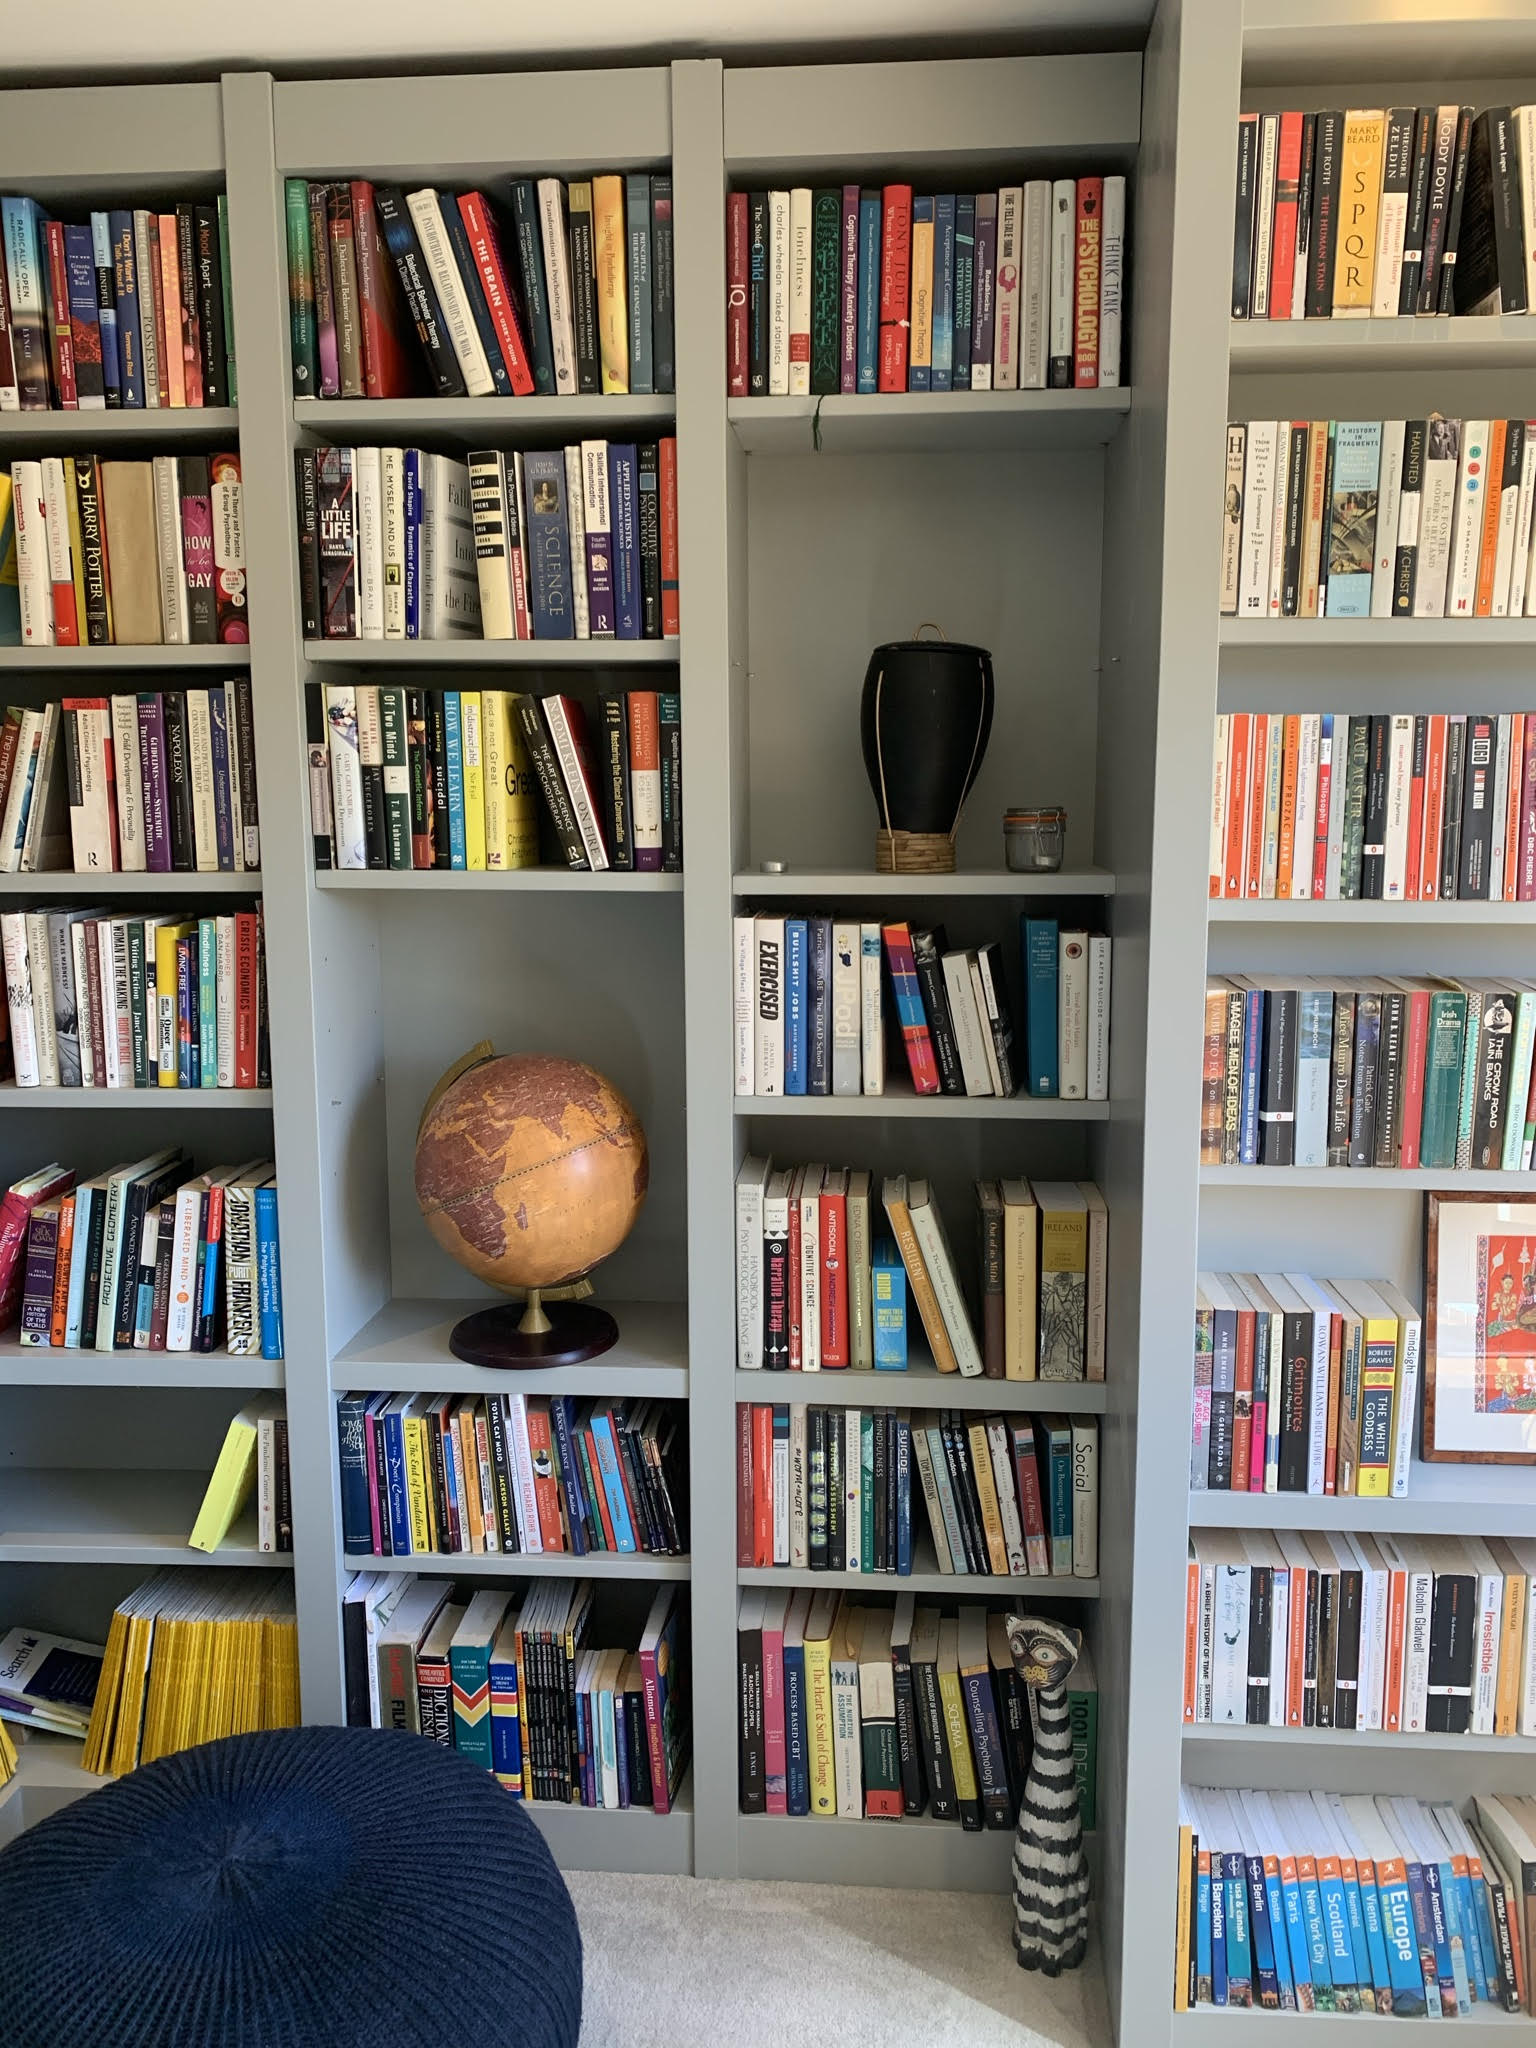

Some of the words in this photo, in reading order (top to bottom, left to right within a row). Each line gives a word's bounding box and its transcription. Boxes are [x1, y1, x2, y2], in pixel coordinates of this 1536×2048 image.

[1325, 119, 1334, 152] PHILIP
[1348, 136, 1380, 144] BEARD
[1388, 126, 1400, 178] ZELDIN
[1400, 126, 1410, 178] THEODORE
[1438, 118, 1452, 162] RODDY
[1322, 156, 1332, 184] ROTH
[1432, 167, 1446, 210] DOYLE
[200, 219, 209, 228] A
[755, 205, 763, 222] The
[1080, 219, 1099, 230] THE
[16, 219, 25, 269] RADICALLY
[21, 269, 30, 298] OPEN
[200, 229, 211, 257] Mood
[1105, 236, 1121, 276] THINK
[201, 258, 212, 288] Apart
[752, 245, 764, 281] Child
[99, 266, 108, 306] MINDFUL
[405, 254, 418, 289] Dialectical
[417, 289, 430, 321] Behavior
[427, 321, 440, 349] Therapy
[476, 238, 490, 262] THE
[484, 267, 502, 307] BRAIN
[500, 318, 513, 342] USER'S
[508, 343, 518, 366] GUIDE
[729, 284, 746, 309] IQ
[1077, 234, 1099, 351] PSYCHOLOGY
[1103, 283, 1119, 316] TANK
[1078, 352, 1096, 361] BOOK
[596, 451, 604, 477] Skilled
[1409, 431, 1422, 484] HAUNTED
[587, 453, 595, 509] Communication
[82, 494, 99, 545] HARRY
[321, 510, 350, 521] LITTLE
[332, 498, 338, 509] A
[598, 478, 606, 526] Interpersonal
[184, 536, 212, 550] HOW
[322, 522, 351, 539] LIFE
[640, 494, 649, 558] PSYCHOLOGY
[647, 494, 657, 558] COGNITIVE
[86, 546, 103, 601] POTTER
[199, 557, 210, 565] be
[544, 527, 564, 616] SCIENCE
[188, 573, 212, 588] GAY
[384, 695, 395, 706] Of
[385, 708, 395, 727] Two
[445, 700, 457, 732] HOW
[386, 730, 395, 759] Minds
[447, 733, 459, 761] WE
[1354, 725, 1368, 760] PAUL
[1475, 724, 1489, 736] NO
[171, 724, 183, 784] NAPOLEON
[1474, 740, 1488, 762] LOGO
[436, 766, 446, 810] suicidal
[448, 765, 461, 813] LEARN
[534, 757, 563, 830] PSYCHOTHERAPY
[541, 744, 551, 761] THE
[546, 762, 556, 779] ART
[551, 778, 561, 796] and
[556, 795, 574, 832] SCIENCE
[549, 701, 568, 751] NAOMI
[562, 752, 583, 794] KLEIN
[577, 800, 589, 822] ON
[583, 826, 600, 856] FIRE
[1352, 762, 1366, 819] AUSTER
[1318, 776, 1330, 825] Philosophy
[113, 926, 125, 953] WOMAN
[202, 924, 210, 976] Mindfulness
[240, 921, 250, 952] CRISIS
[114, 955, 126, 963] IN
[115, 966, 126, 978] THE
[116, 981, 128, 1010] MAKING
[240, 956, 250, 1010] ECONOMICS
[760, 940, 779, 1020] EXERCISED
[1230, 1002, 1241, 1048] MAGEE
[1437, 1018, 1461, 1027] Drama
[1441, 1010, 1458, 1018] Irish
[1228, 1048, 1239, 1074] MEN
[1488, 1038, 1496, 1060] IAIN
[1495, 1038, 1504, 1060] THE
[1228, 1076, 1238, 1096] OF
[1484, 1063, 1494, 1100] BANKS
[1492, 1062, 1502, 1096] CROW
[1226, 1096, 1238, 1132] IDEAS
[1490, 1098, 1499, 1128] ROAD
[107, 1182, 119, 1242] GEOMETRY
[230, 1199, 249, 1264] JONATHAN
[828, 1209, 838, 1257] ANTISOCIAL
[901, 1230, 926, 1282] RESILIENT
[102, 1247, 114, 1306] PROJECTIVE
[771, 1257, 785, 1298] Narrative
[232, 1280, 252, 1336] FRANZEN
[768, 1300, 785, 1333] Therapy
[1367, 1349, 1393, 1357] ROBERT
[1367, 1356, 1393, 1365] GRAVES
[1403, 1328, 1417, 1376] mindsight
[1377, 1396, 1389, 1416] THE
[1363, 1402, 1376, 1452] GODDESS
[1375, 1419, 1387, 1458] WHITE
[875, 1419, 883, 1478] MINDFULNESS
[900, 1429, 908, 1478] SUICIDE:
[1075, 1442, 1092, 1494] Social
[499, 1475, 507, 1506] JACKSON
[1415, 1577, 1428, 1616] Malcolm
[1412, 1617, 1426, 1654] Gladwell
[1480, 1611, 1496, 1674] Irresistible
[1, 1648, 32, 1680] Search
[814, 1668, 825, 1684] The
[645, 1677, 655, 1721] Allotment
[815, 1686, 824, 1710] Heart
[816, 1723, 828, 1742] Soul
[897, 1698, 910, 1762] MINDFULNESS
[947, 1703, 964, 1749] SCHEMA
[968, 1679, 984, 1733] Counselling
[977, 1735, 994, 1786] Psychology
[1071, 1699, 1089, 1740] 1001
[792, 1740, 800, 1760] CBT
[816, 1754, 830, 1787] Change
[1212, 1883, 1223, 1939] Barcelona
[1253, 1884, 1263, 1912] Berlin
[1270, 1890, 1281, 1923] Boston
[1287, 1892, 1299, 1924] Paris
[1306, 1890, 1316, 1914] New
[1366, 1894, 1379, 1932] Vienna
[1236, 1910, 1246, 1942] canada
[1310, 1916, 1322, 1940] York
[1327, 1892, 1349, 1958] Scotland
[1389, 1890, 1414, 1962] Europe
[1430, 1892, 1445, 1944] Amsterdam
[1312, 1944, 1324, 1964] City
